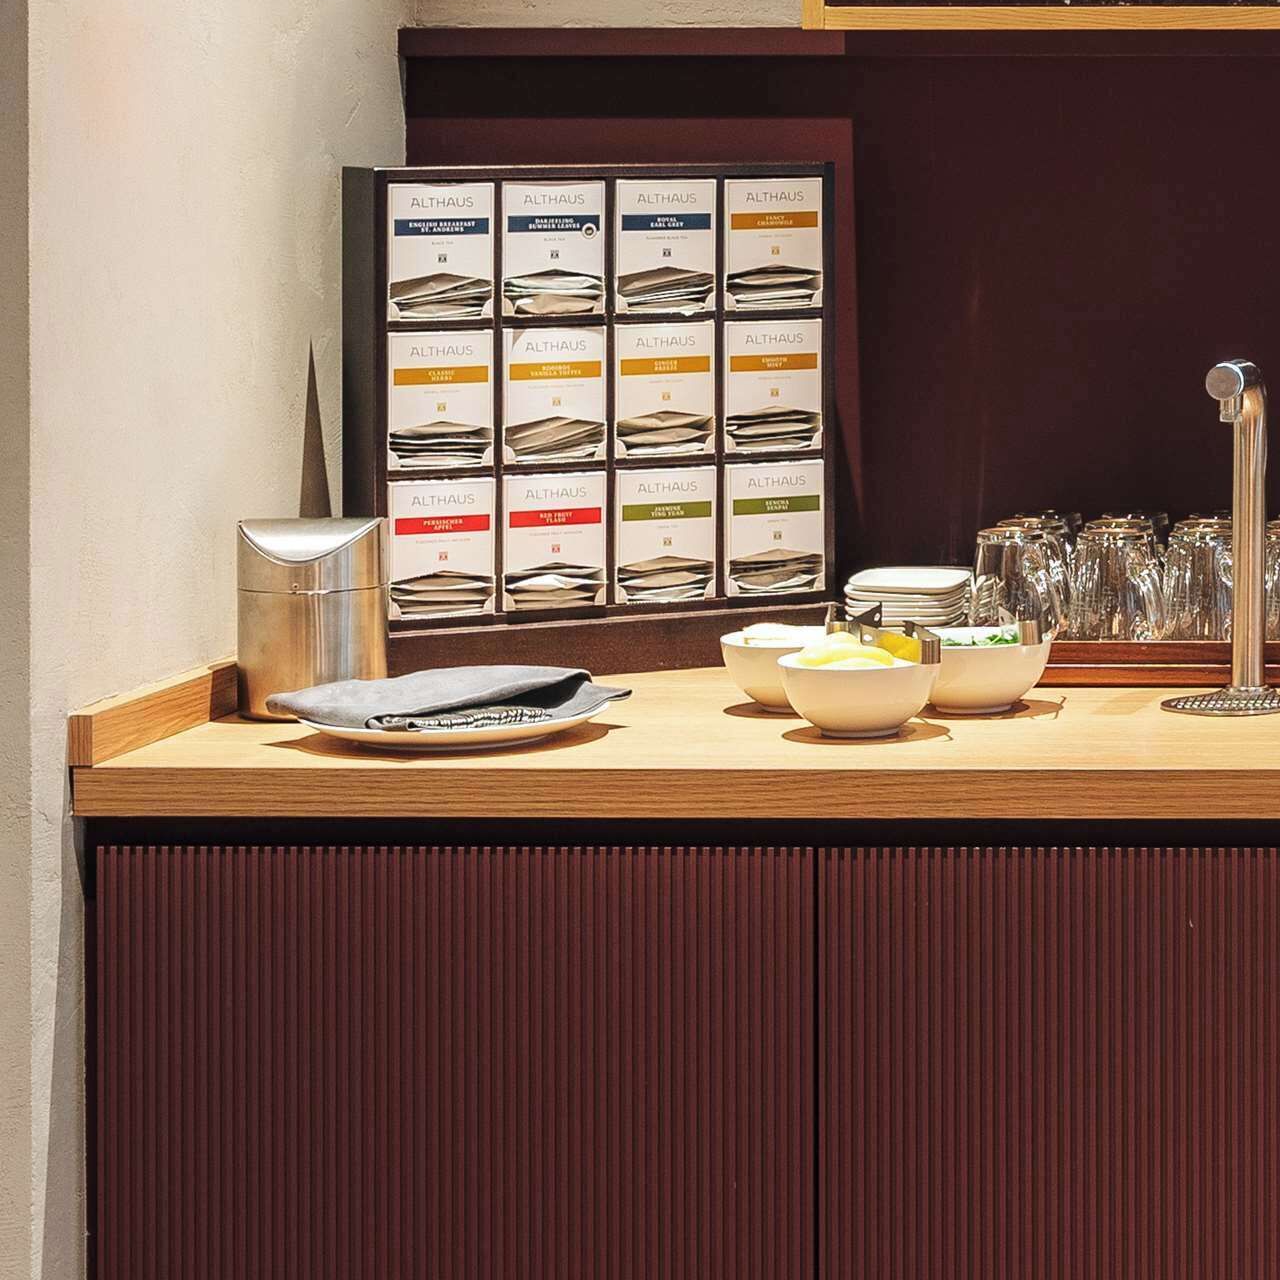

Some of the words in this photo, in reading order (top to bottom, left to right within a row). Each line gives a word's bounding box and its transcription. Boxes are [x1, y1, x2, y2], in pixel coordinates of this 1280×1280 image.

[411, 196, 475, 208] ALTHAUS
[524, 193, 585, 206] ALTHAUS
[637, 192, 697, 204] ALTHAUS
[746, 191, 804, 202] ALTHAUS
[636, 335, 696, 348] ALTHAUS
[746, 332, 804, 344] ALTHAUS
[410, 345, 474, 357] ALTHAUS
[525, 339, 587, 353] ALTHAUS
[638, 480, 698, 493] ALTHAUS
[748, 475, 807, 488] ALTHAUS
[412, 493, 477, 506] ALTHAUS
[526, 486, 588, 500] ALTHAUS
